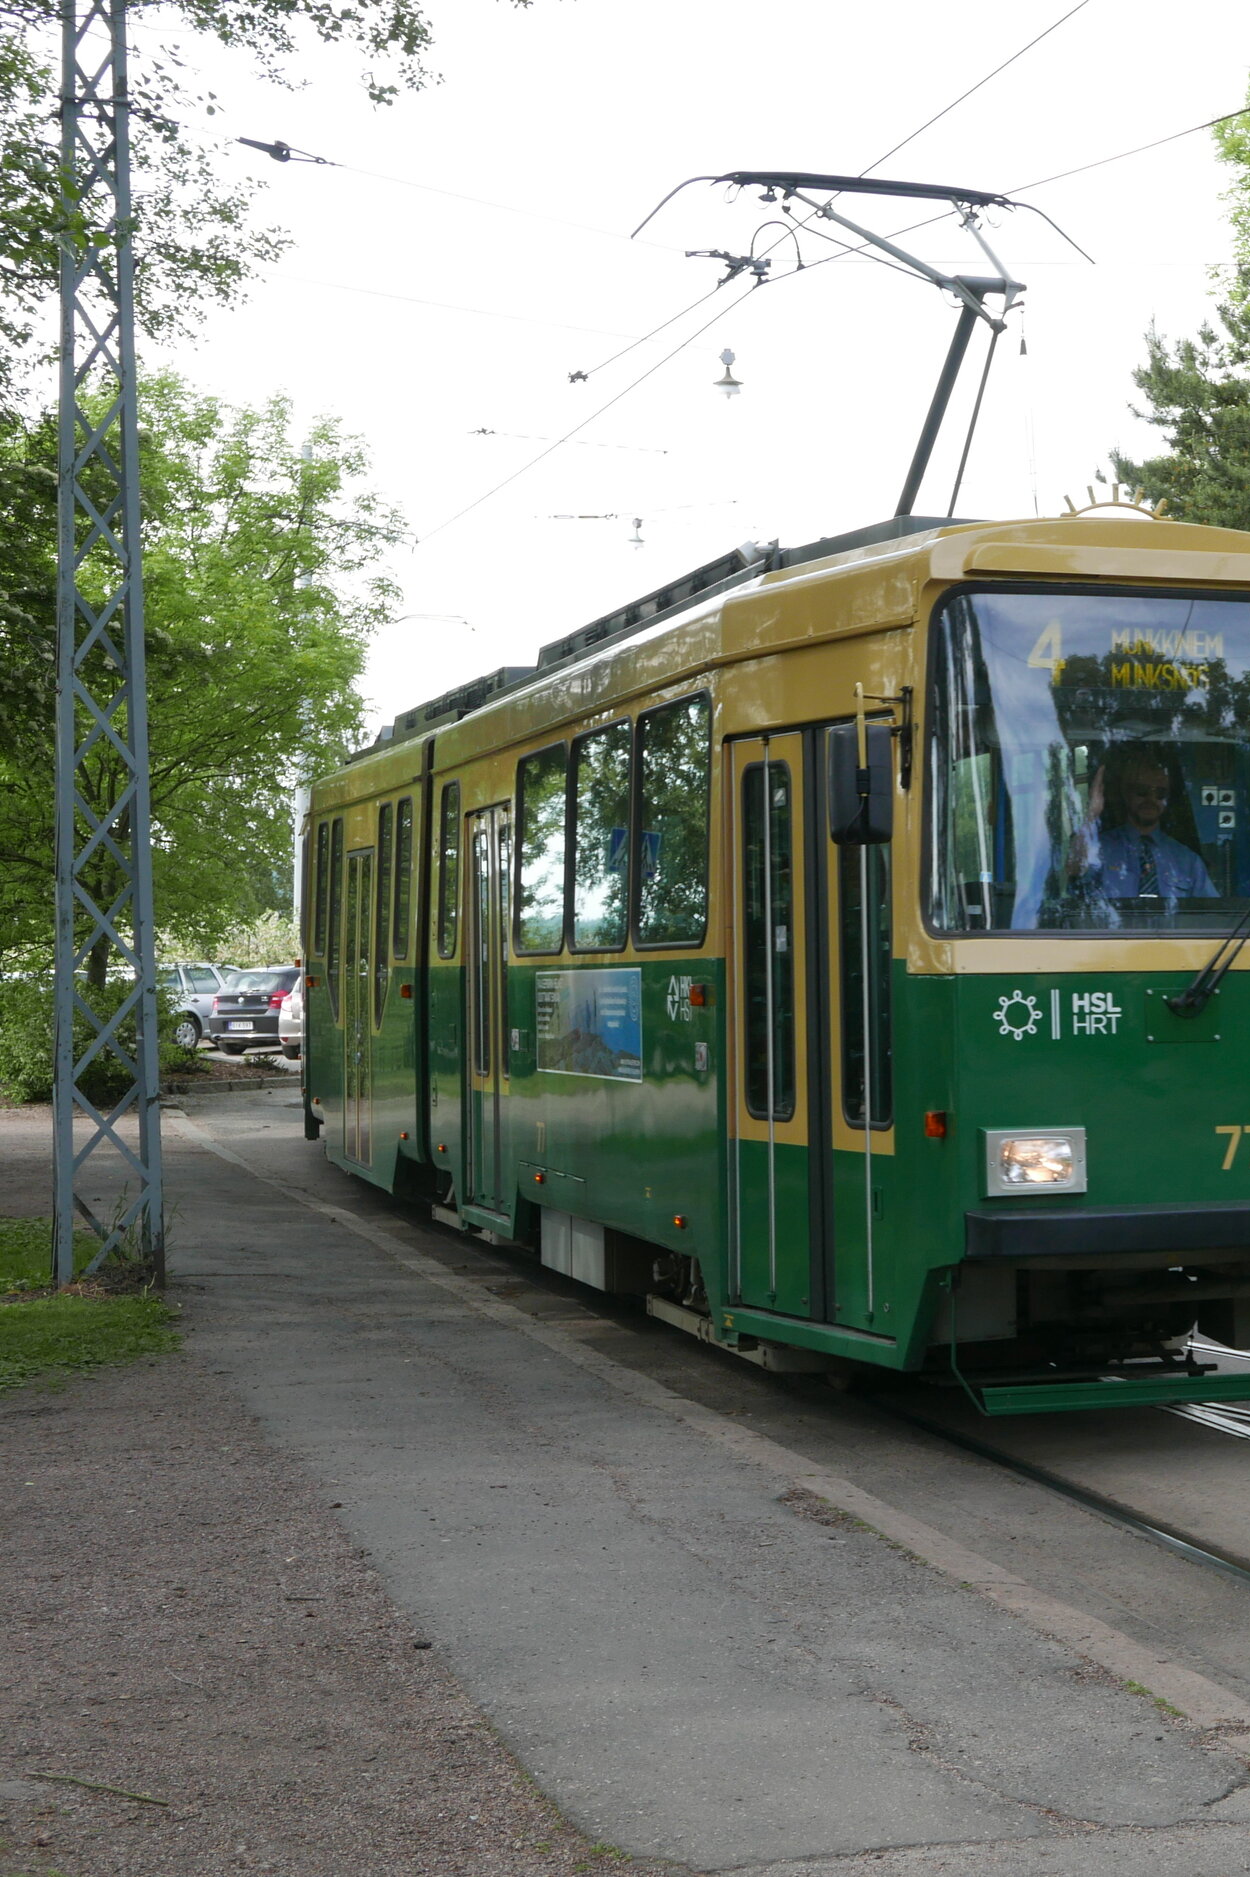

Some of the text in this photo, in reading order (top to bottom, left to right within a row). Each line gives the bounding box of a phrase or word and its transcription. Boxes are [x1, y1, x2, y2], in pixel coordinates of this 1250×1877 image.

[1027, 618, 1066, 686] 4
[1111, 627, 1223, 658] MUNKKINIEMI
[1072, 992, 1122, 1013] HSL
[1073, 1014, 1122, 1035] HRT
